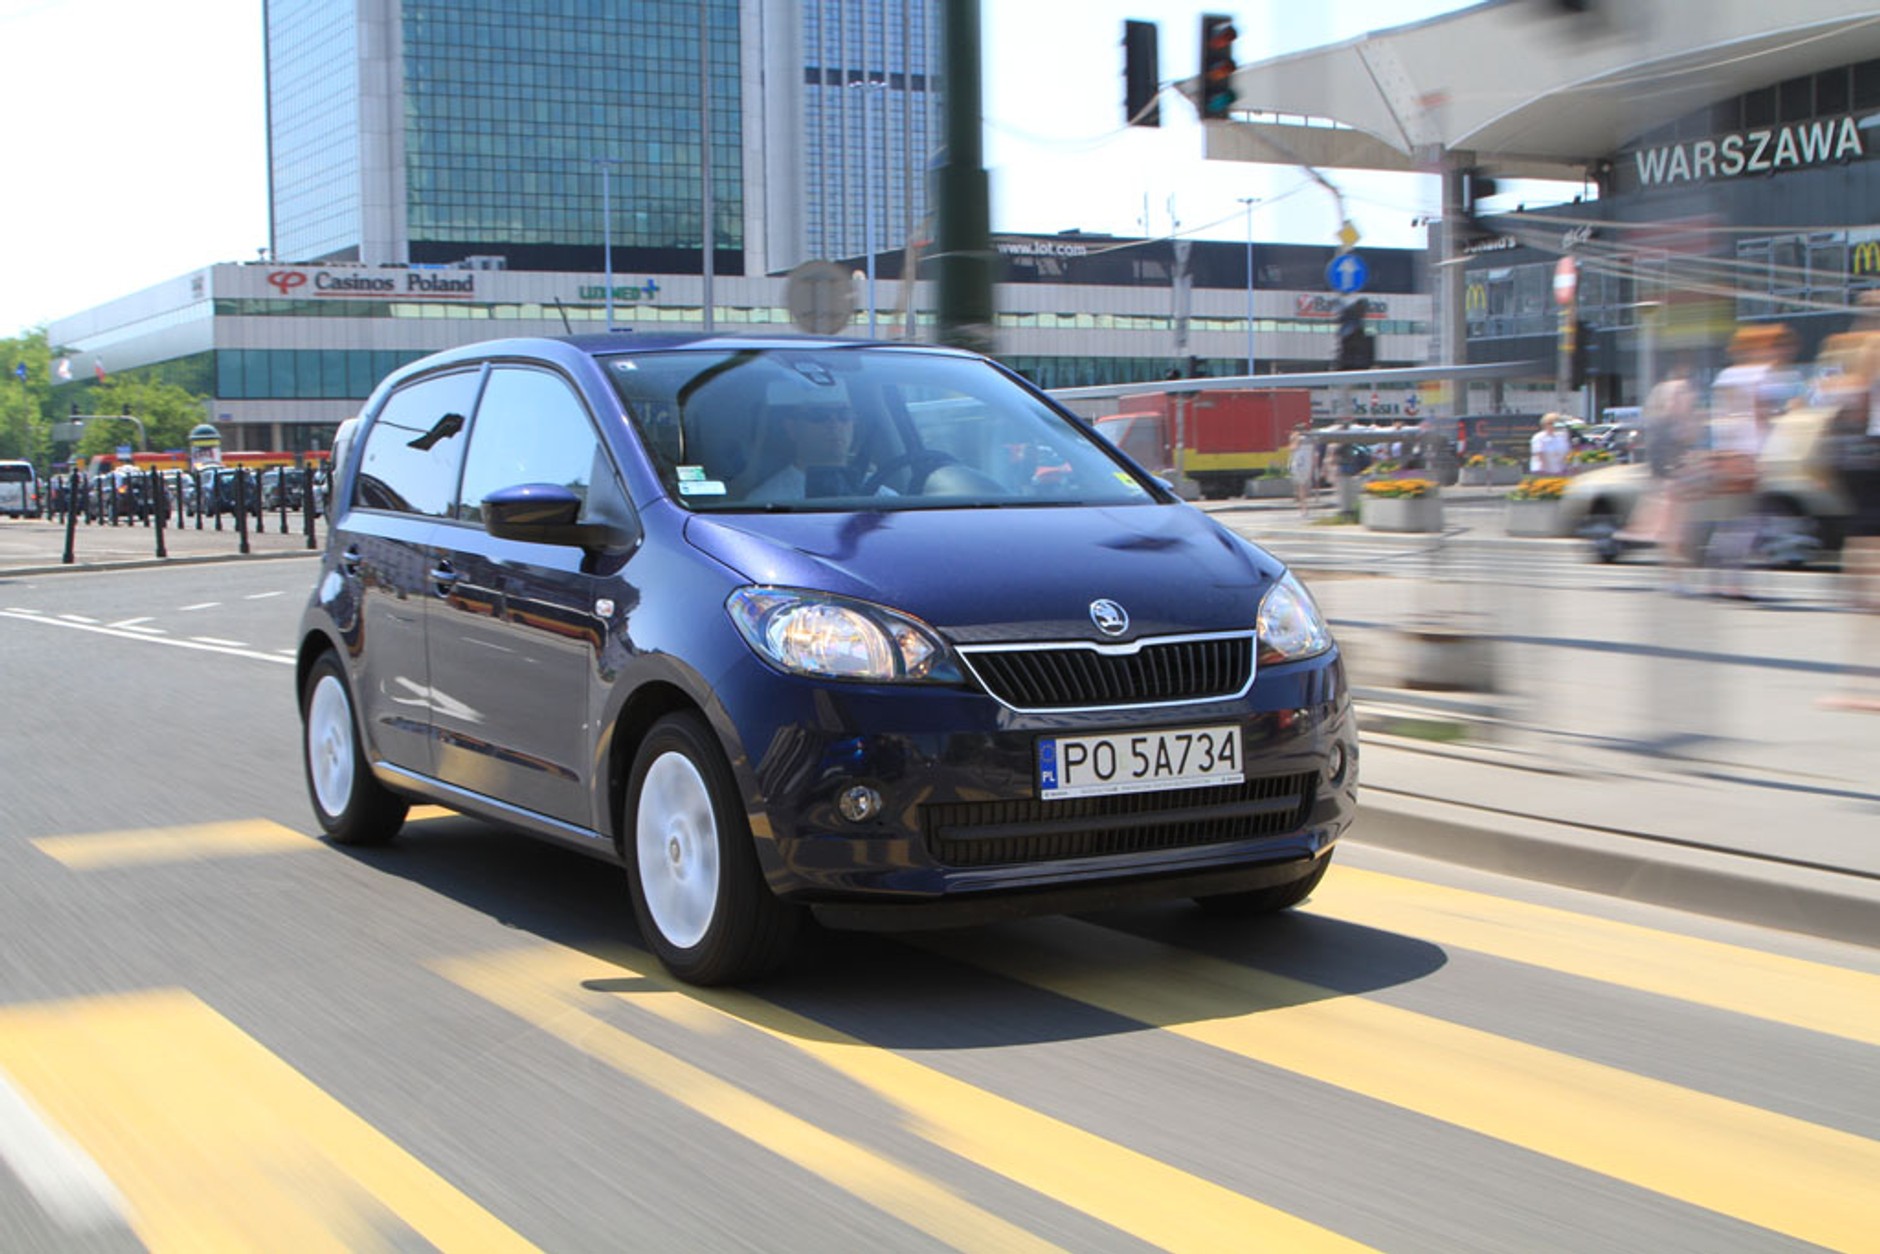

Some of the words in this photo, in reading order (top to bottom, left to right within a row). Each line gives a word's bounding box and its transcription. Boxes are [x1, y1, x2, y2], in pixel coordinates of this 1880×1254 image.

[1635, 116, 1863, 185] WARSZAWA
[996, 242, 1087, 256] www.lot.com
[314, 271, 394, 291] Casinos
[407, 273, 474, 292] Poland
[1064, 740, 1116, 784] PO
[1131, 731, 1236, 777] 5A734
[1042, 771, 1055, 783] PL
